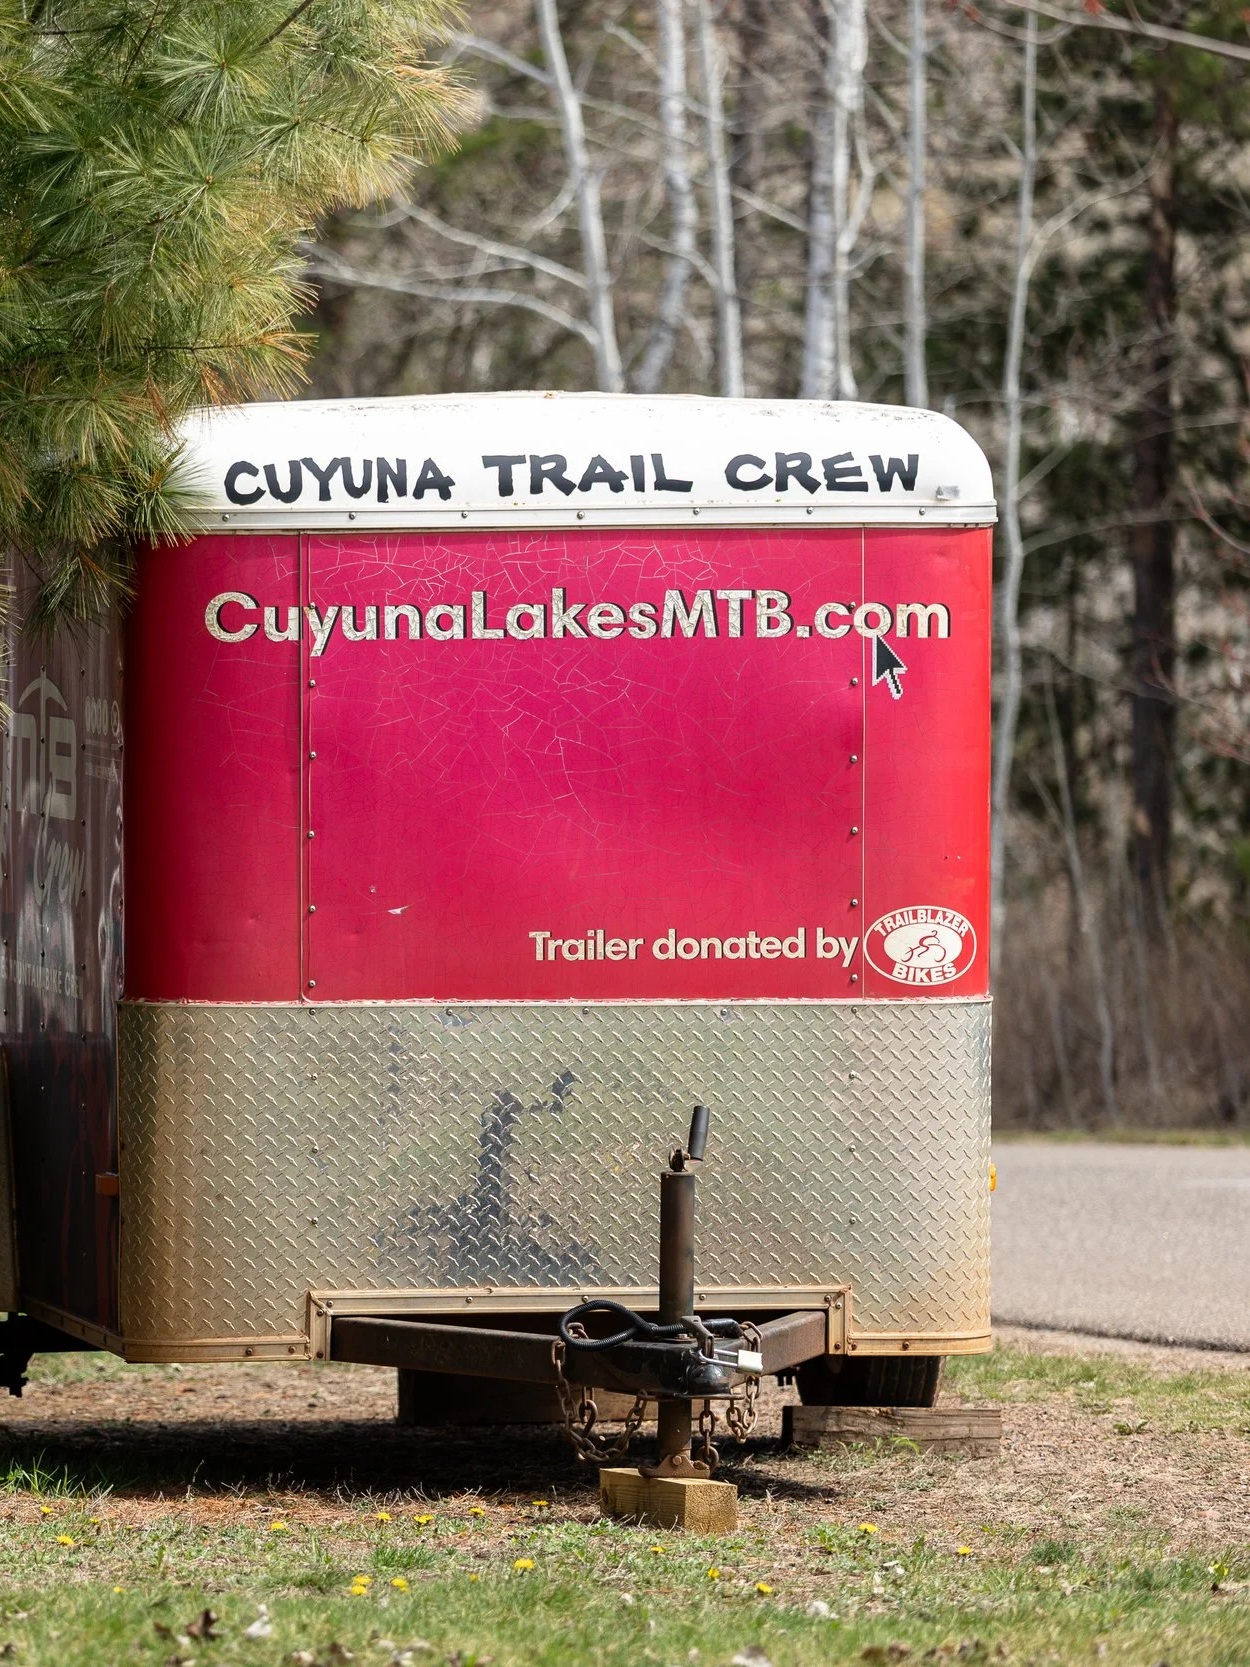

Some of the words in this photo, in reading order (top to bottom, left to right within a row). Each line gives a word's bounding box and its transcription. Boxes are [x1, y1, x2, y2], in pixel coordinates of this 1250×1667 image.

[224, 457, 455, 503] CUYUNA
[482, 454, 693, 497] TRAIL
[724, 452, 920, 494] CREW
[204, 587, 951, 657] CuyunaLakesMTB.com
[529, 929, 645, 962] Trailer
[652, 927, 808, 961] donated
[817, 926, 860, 968] by
[891, 962, 958, 982] BIKES
